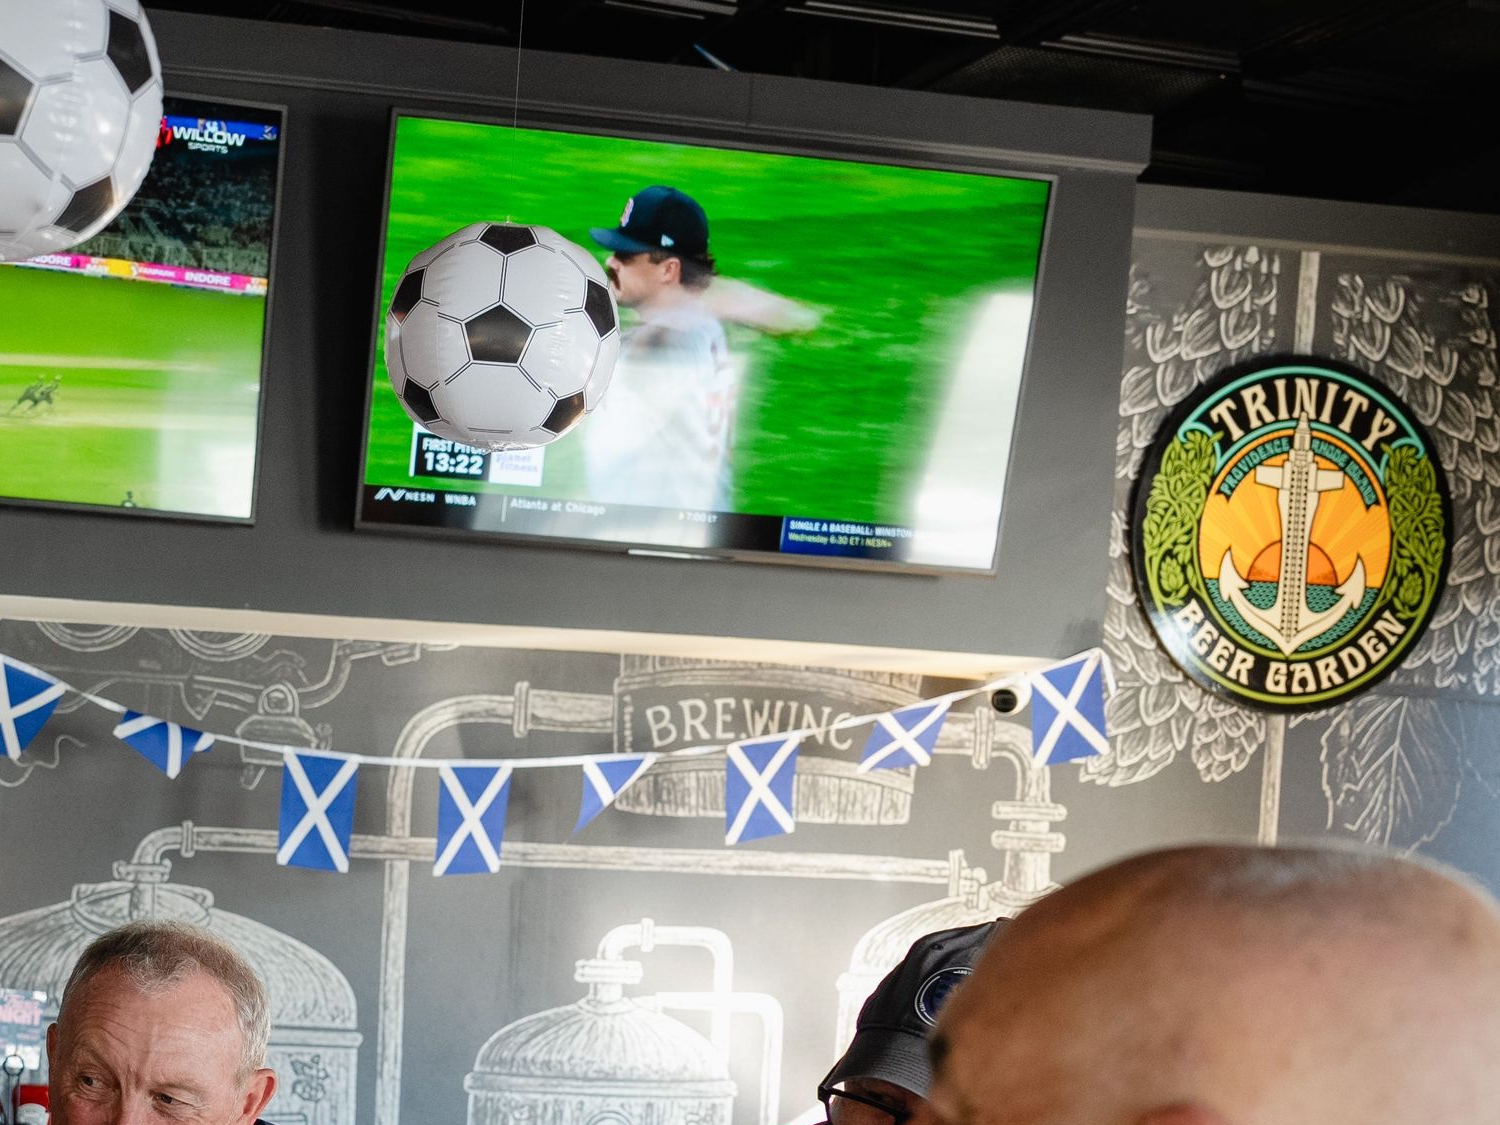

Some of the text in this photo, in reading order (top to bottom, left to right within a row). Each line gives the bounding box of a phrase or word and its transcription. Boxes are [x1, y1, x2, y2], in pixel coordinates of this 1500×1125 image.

[173, 126, 246, 147] WILLOW
[188, 142, 229, 154] SPORTS
[28, 253, 71, 268] NDORE
[184, 271, 232, 287] INDORE
[1210, 377, 1397, 451] TRINITY
[423, 437, 452, 452] FIRST
[424, 452, 484, 475] 13:22
[1219, 437, 1378, 506] PROVIDENCE RHODE ISLAND
[405, 491, 477, 506] NESN WNBA
[510, 497, 606, 516] Atlanta at Chicago
[789, 519, 821, 532] SINGLE
[821, 521, 828, 532] A
[850, 536, 861, 546] ET
[1174, 599, 1407, 694] BEER GARDEN
